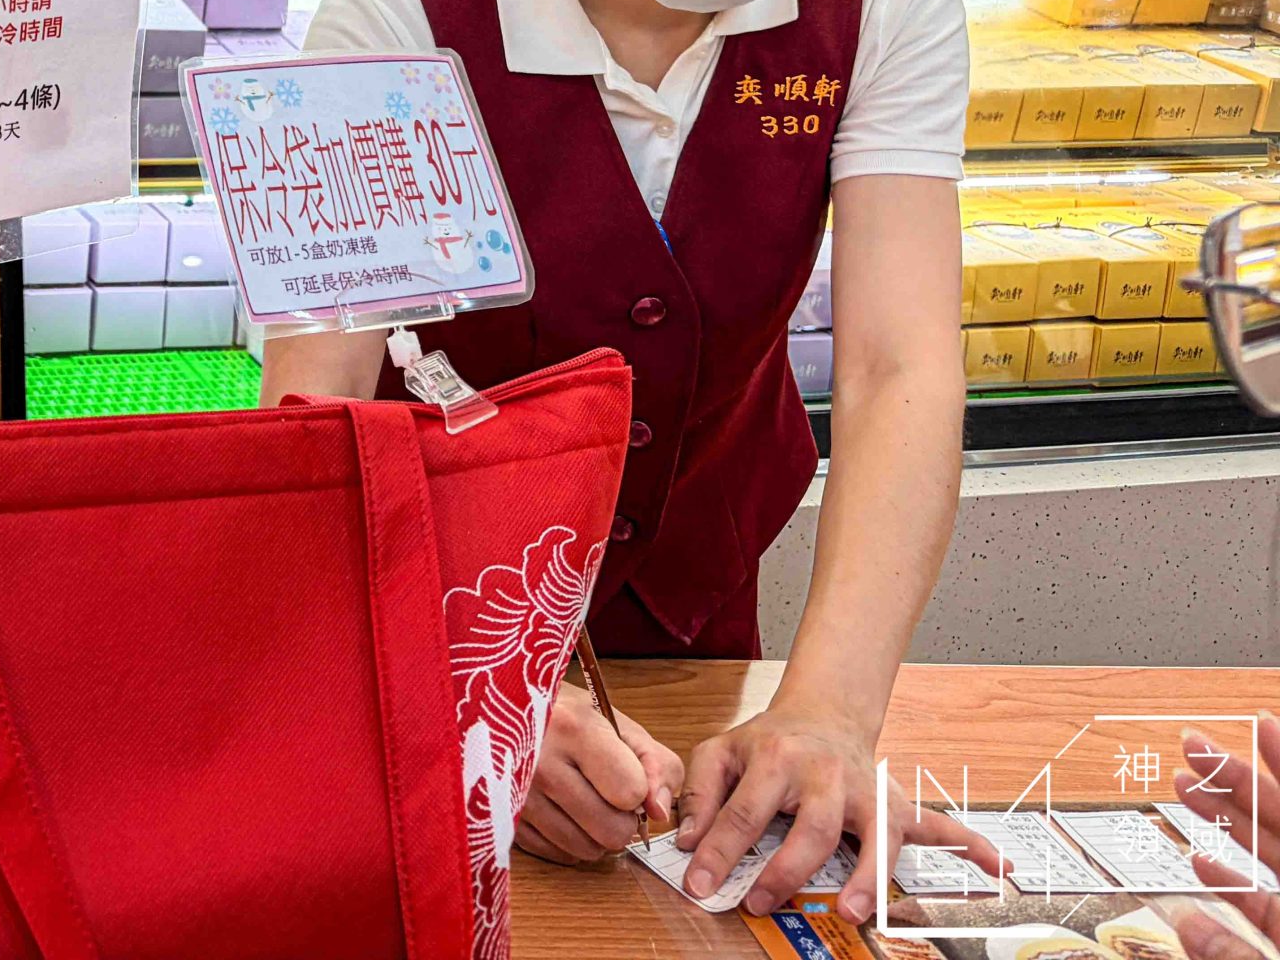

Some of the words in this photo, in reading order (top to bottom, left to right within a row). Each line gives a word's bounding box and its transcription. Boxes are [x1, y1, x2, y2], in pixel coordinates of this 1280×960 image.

[215, 116, 499, 246] 保冷袋加價購30元
[281, 264, 413, 297] 可延長保冷時間
